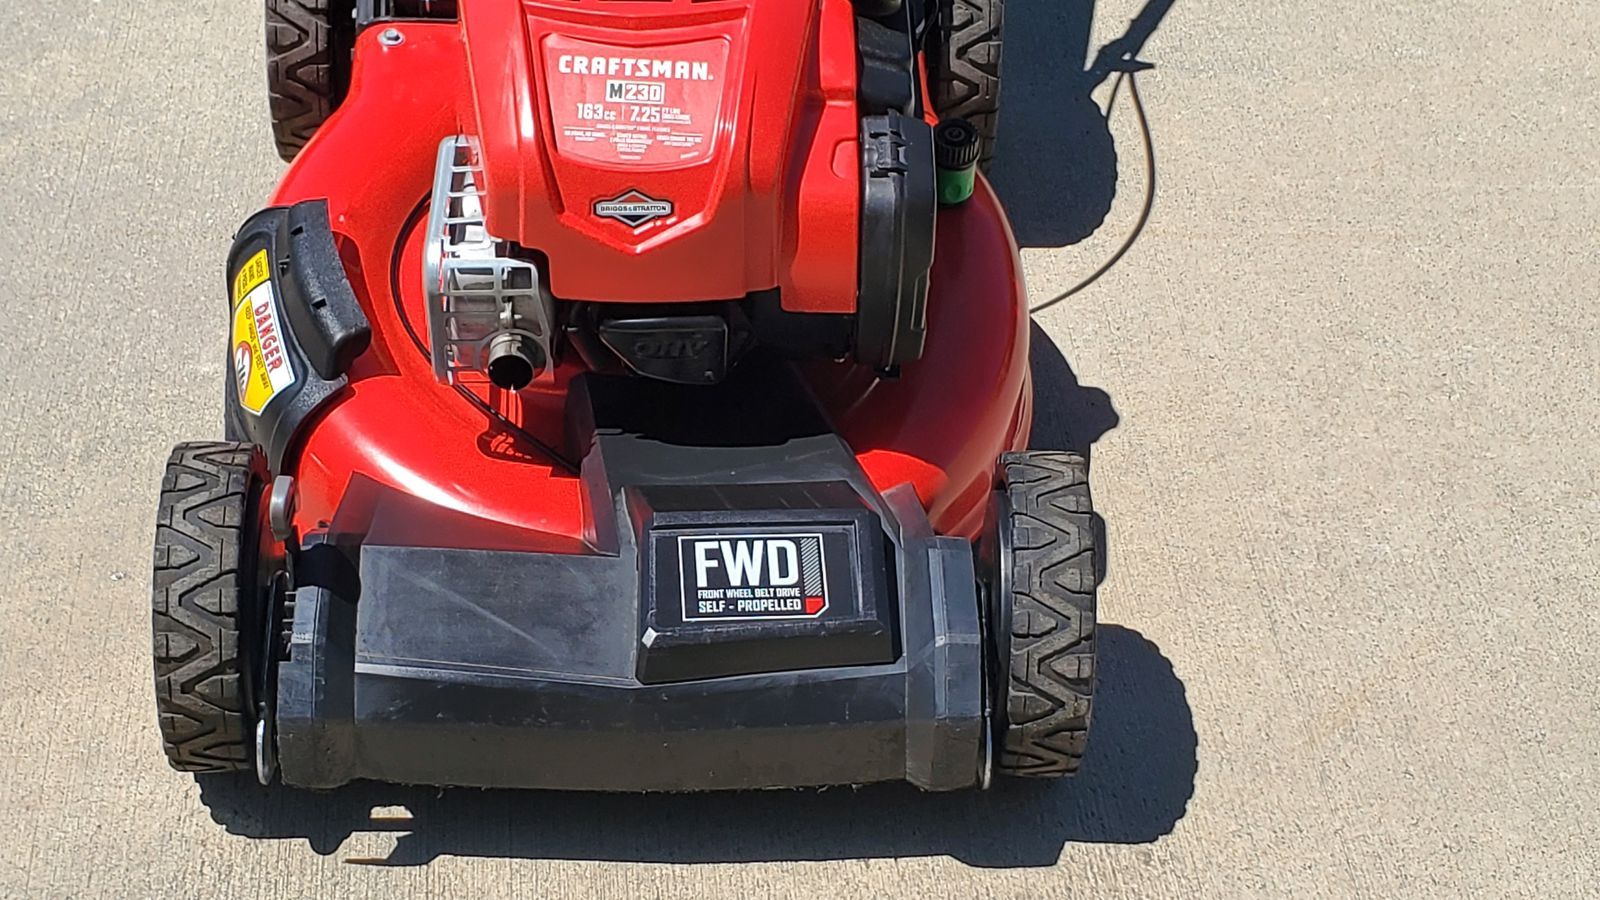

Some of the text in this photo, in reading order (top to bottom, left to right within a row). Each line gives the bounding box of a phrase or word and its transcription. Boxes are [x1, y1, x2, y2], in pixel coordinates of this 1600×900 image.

[576, 103, 616, 120] 163cc
[630, 106, 660, 122] 7.25
[254, 301, 283, 373] DANGER
[694, 540, 799, 587] FWD
[698, 587, 800, 599] FRONT WHEEL BELT DRIVE
[699, 601, 726, 613] SELF
[737, 599, 801, 612] PROPELLED
